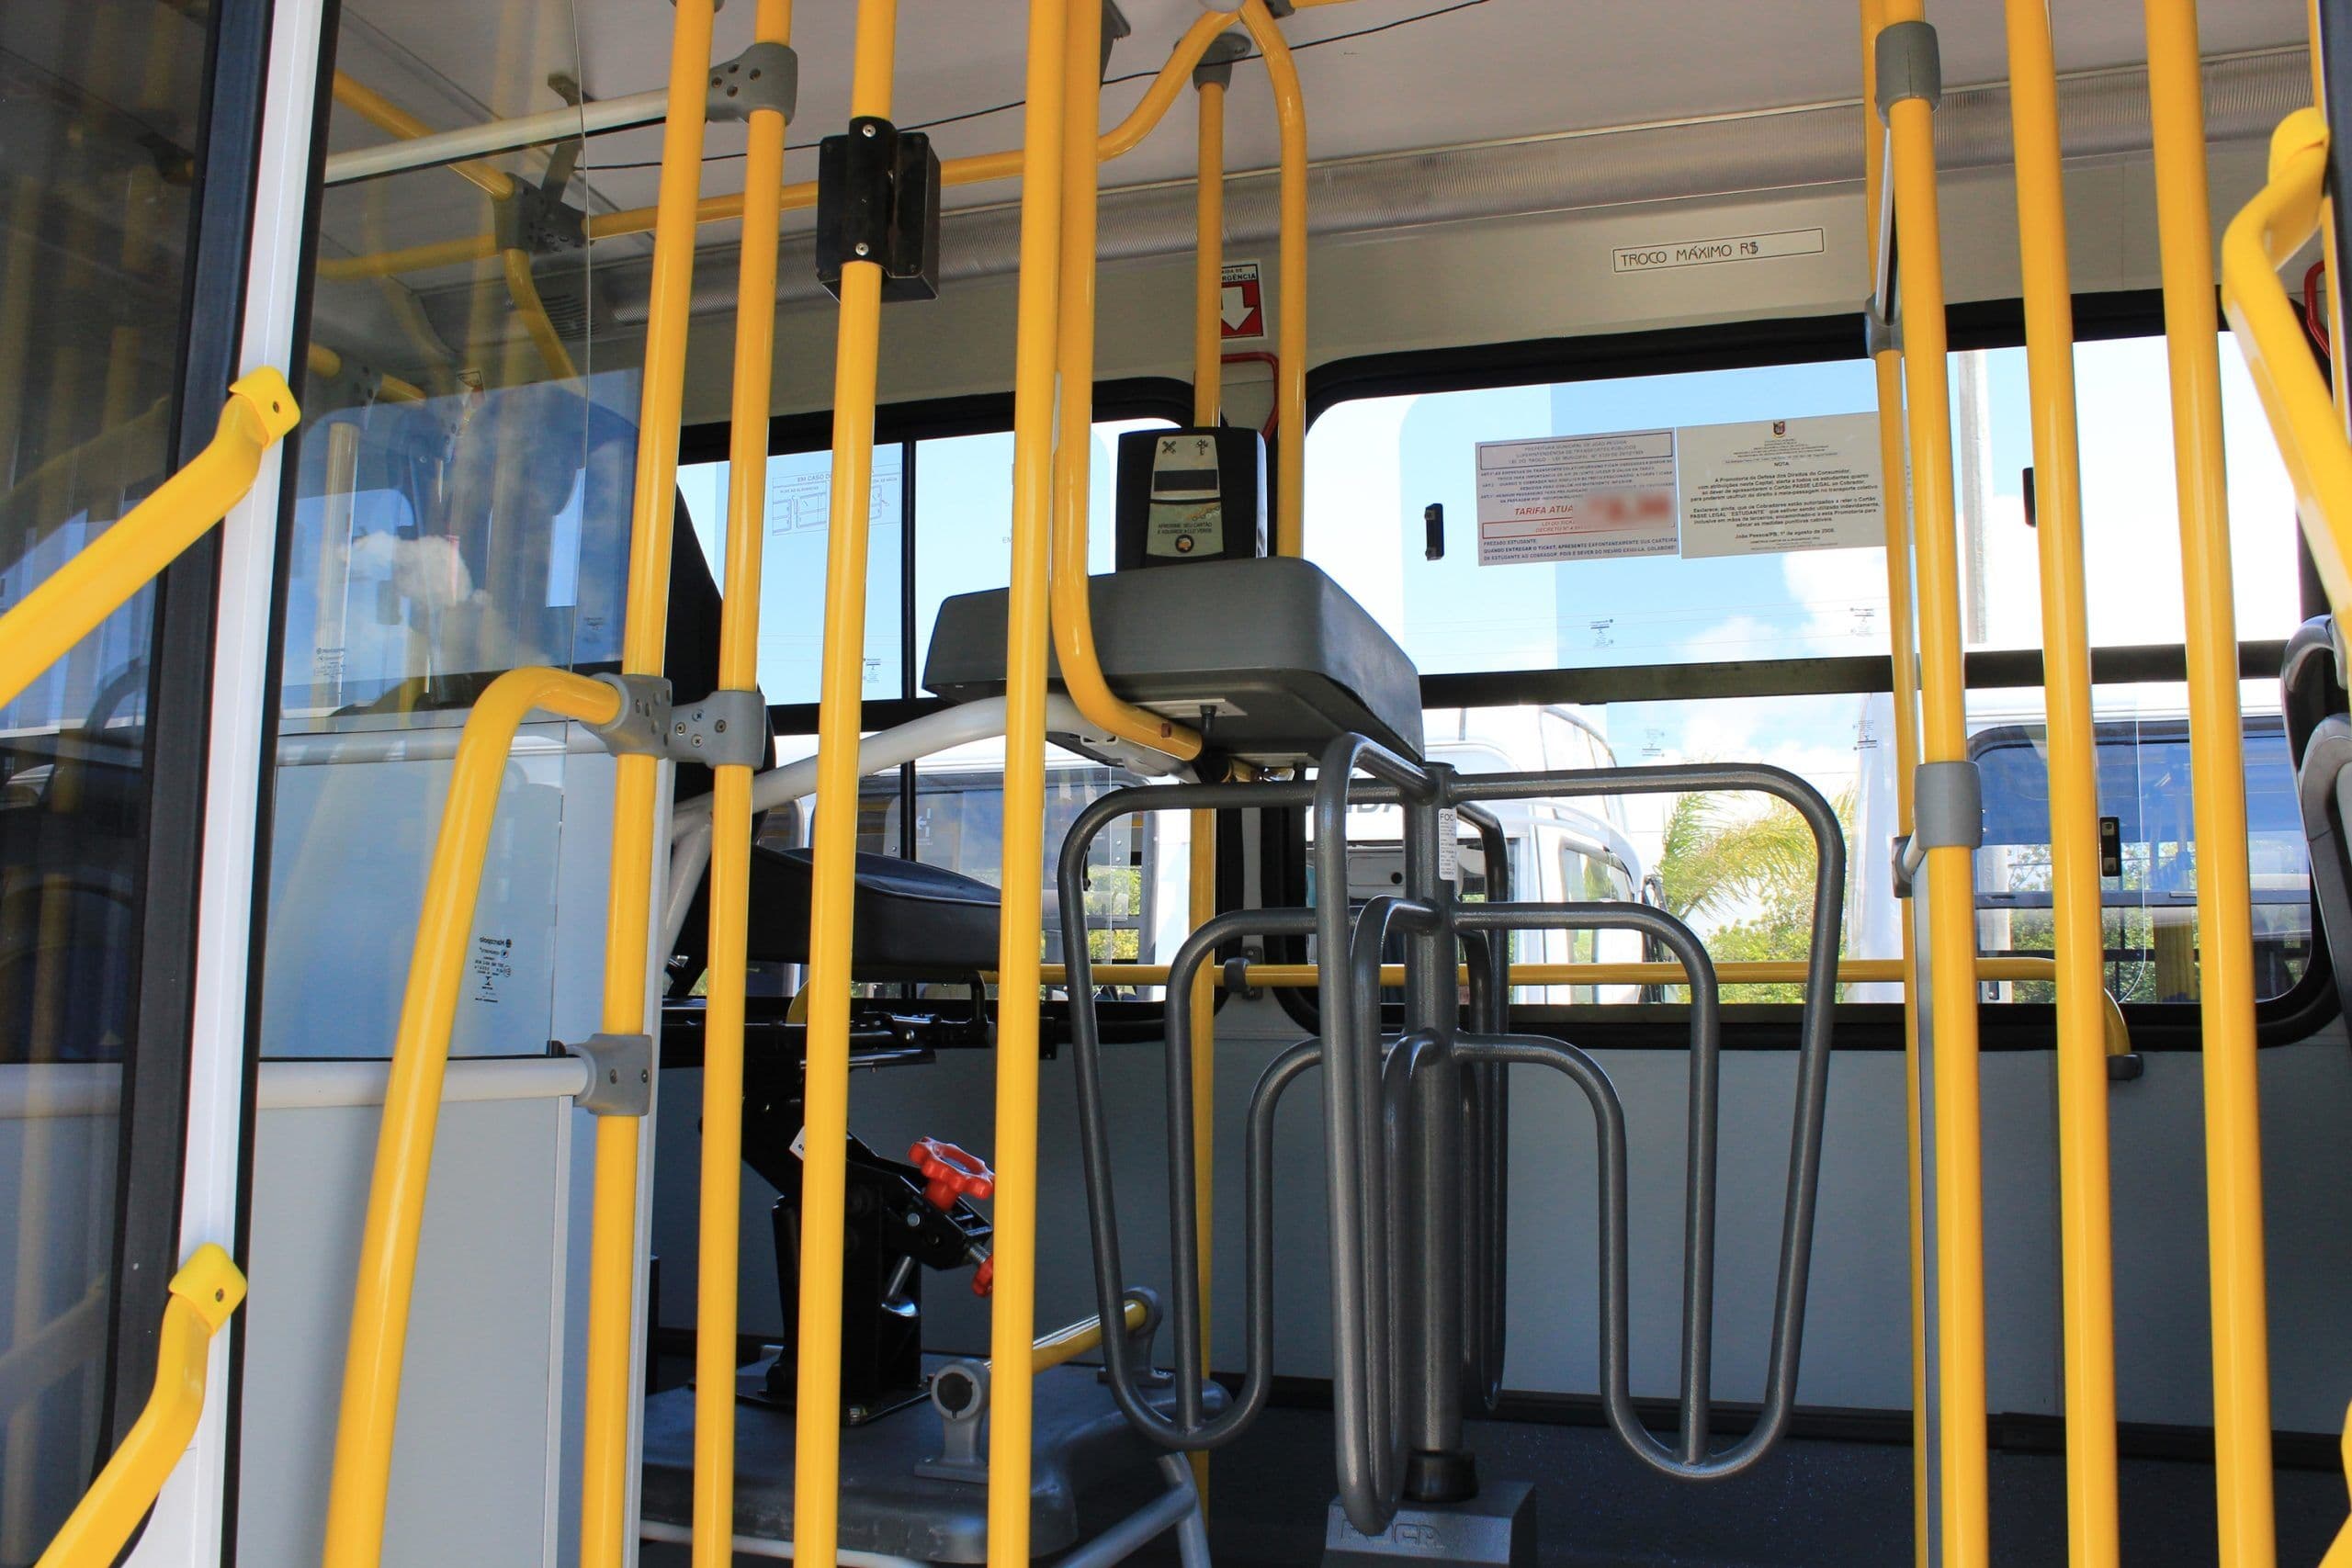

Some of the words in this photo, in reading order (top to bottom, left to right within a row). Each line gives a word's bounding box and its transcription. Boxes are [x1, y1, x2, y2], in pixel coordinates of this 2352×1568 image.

[1621, 251, 1667, 267] TROCO
[1676, 244, 1732, 262] MÁXIMO
[1740, 242, 1758, 256] R$
[1222, 273, 1256, 282] RGÊNCIA
[1515, 506, 1546, 515] TARIFA
[1549, 504, 1573, 513] ATUA
[1440, 813, 1456, 822] FOC
